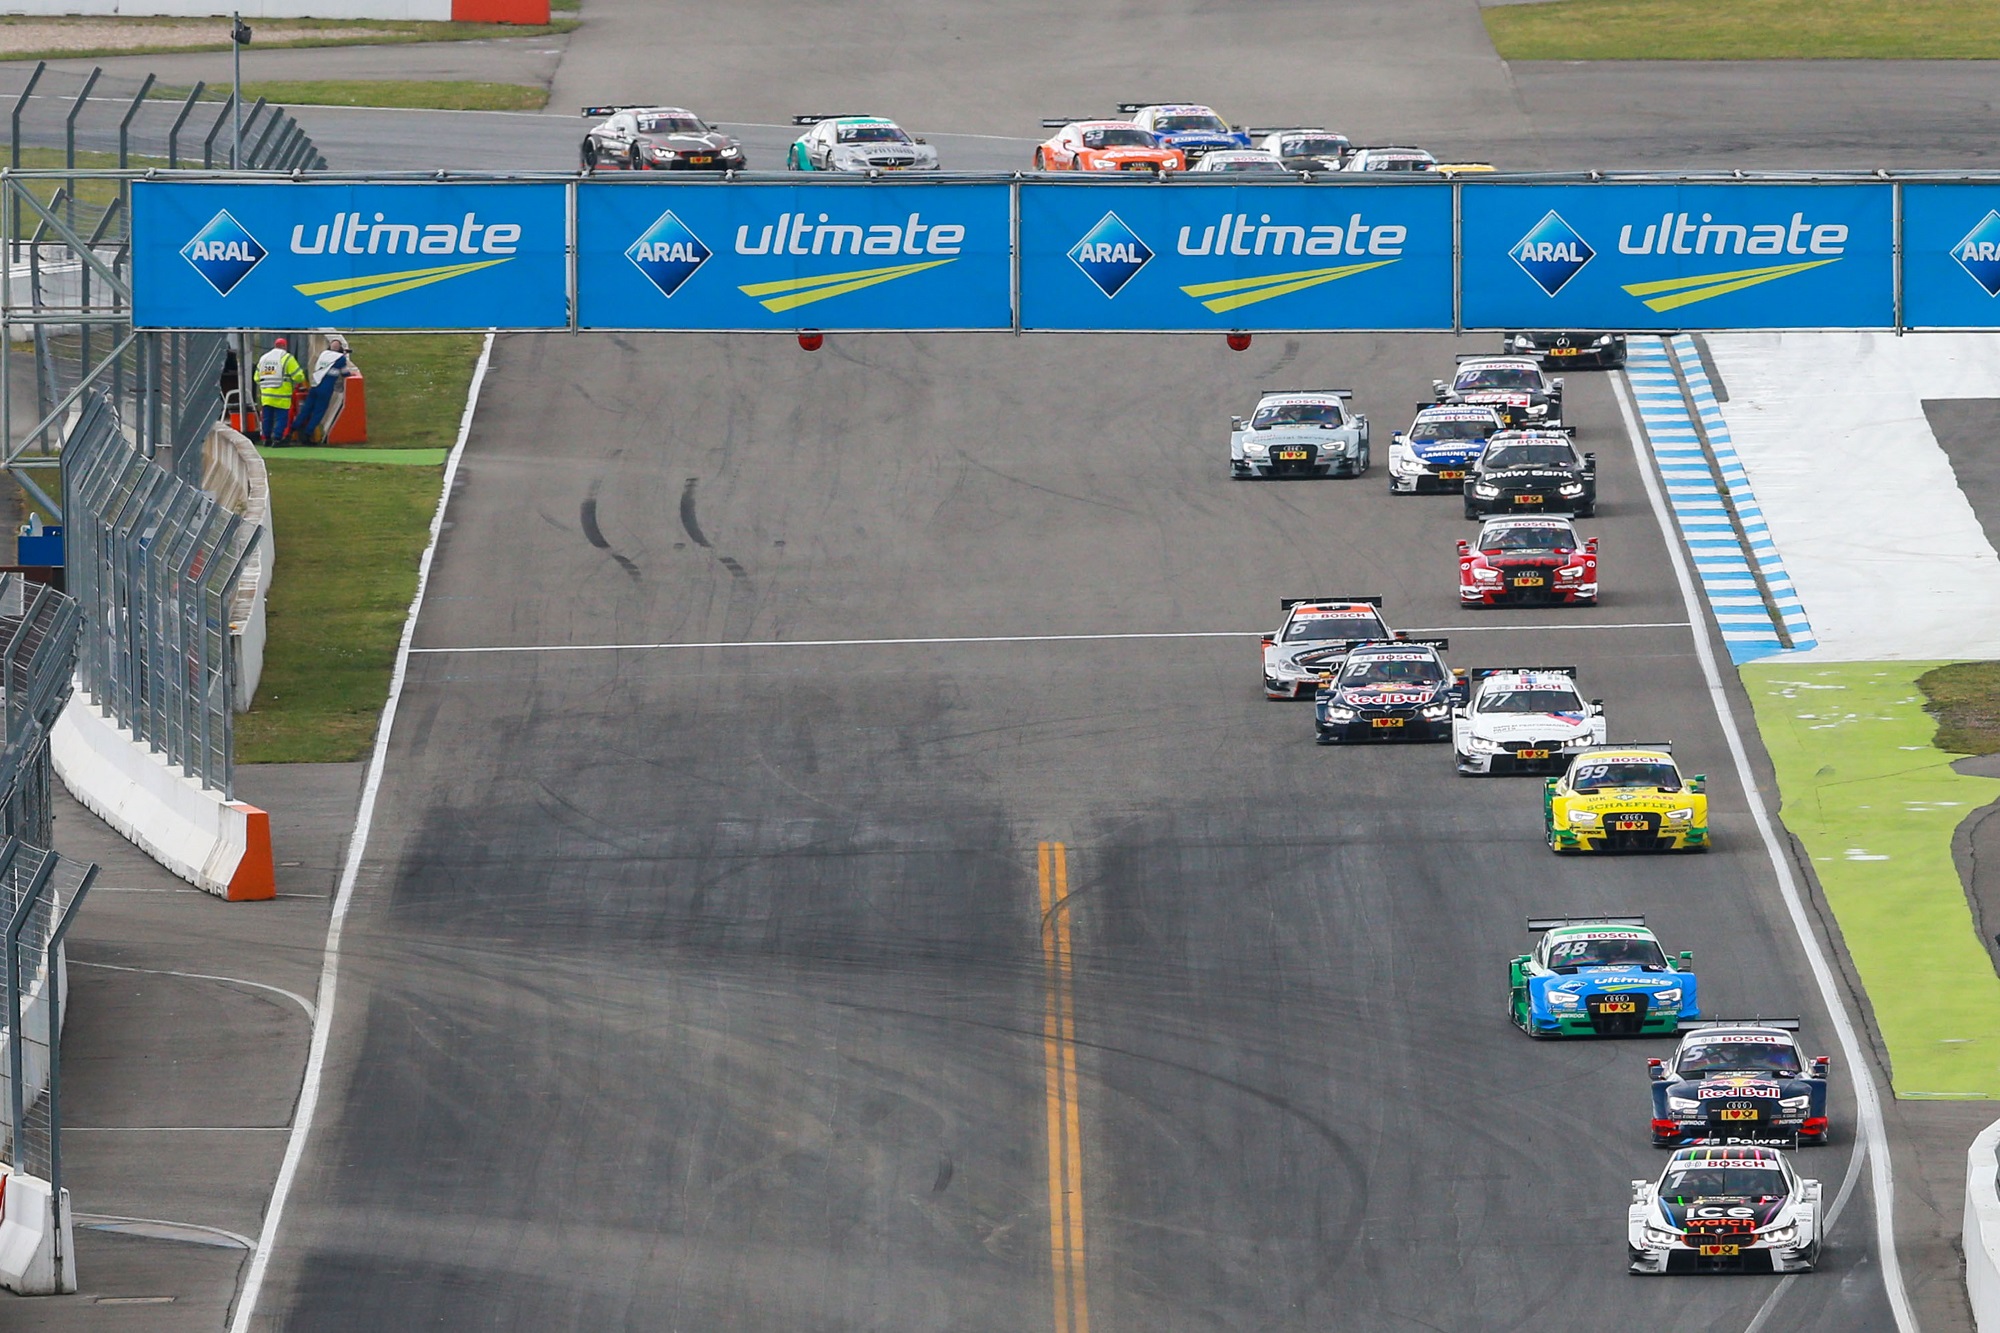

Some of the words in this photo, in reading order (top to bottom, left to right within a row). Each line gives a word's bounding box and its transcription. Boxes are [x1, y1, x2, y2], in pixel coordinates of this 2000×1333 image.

[639, 120, 657, 131] 31
[1156, 118, 1169, 128] 2
[840, 129, 858, 139] 12
[1084, 130, 1105, 141] 53
[1285, 140, 1304, 150] 27
[1366, 161, 1388, 171] 84
[290, 212, 522, 255] ultimate
[735, 212, 965, 255] ultimate
[1177, 213, 1407, 256] ultimate
[1619, 212, 1849, 255] ultimate
[192, 240, 256, 262] ARAL
[636, 241, 700, 262] ARAL
[1079, 242, 1142, 263] ARAL
[1519, 241, 1583, 262] ARAL
[1961, 241, 2000, 262] AR
[1459, 371, 1481, 383] 10
[1258, 407, 1281, 418] 51
[1413, 424, 1440, 437] 36
[1531, 470, 1573, 479] Bank
[1485, 530, 1510, 543] 17
[1290, 621, 1310, 635] 6
[1346, 662, 1372, 677] 13
[1346, 692, 1387, 704] Red
[1389, 692, 1434, 704] Bull
[1481, 692, 1513, 709] 77
[1577, 765, 1609, 780] 99
[1587, 802, 1676, 811] SCHAEFFLER
[1554, 941, 1589, 956] 48
[1594, 976, 1673, 986] ultimate
[1683, 1046, 1707, 1062] 5
[1700, 1087, 1738, 1098] Red
[1742, 1087, 1779, 1098] Bull
[1727, 1137, 1789, 1145] Power
[1670, 1171, 1687, 1189] 1
[1686, 1206, 1755, 1218] ice
[1686, 1218, 1756, 1228] watch
